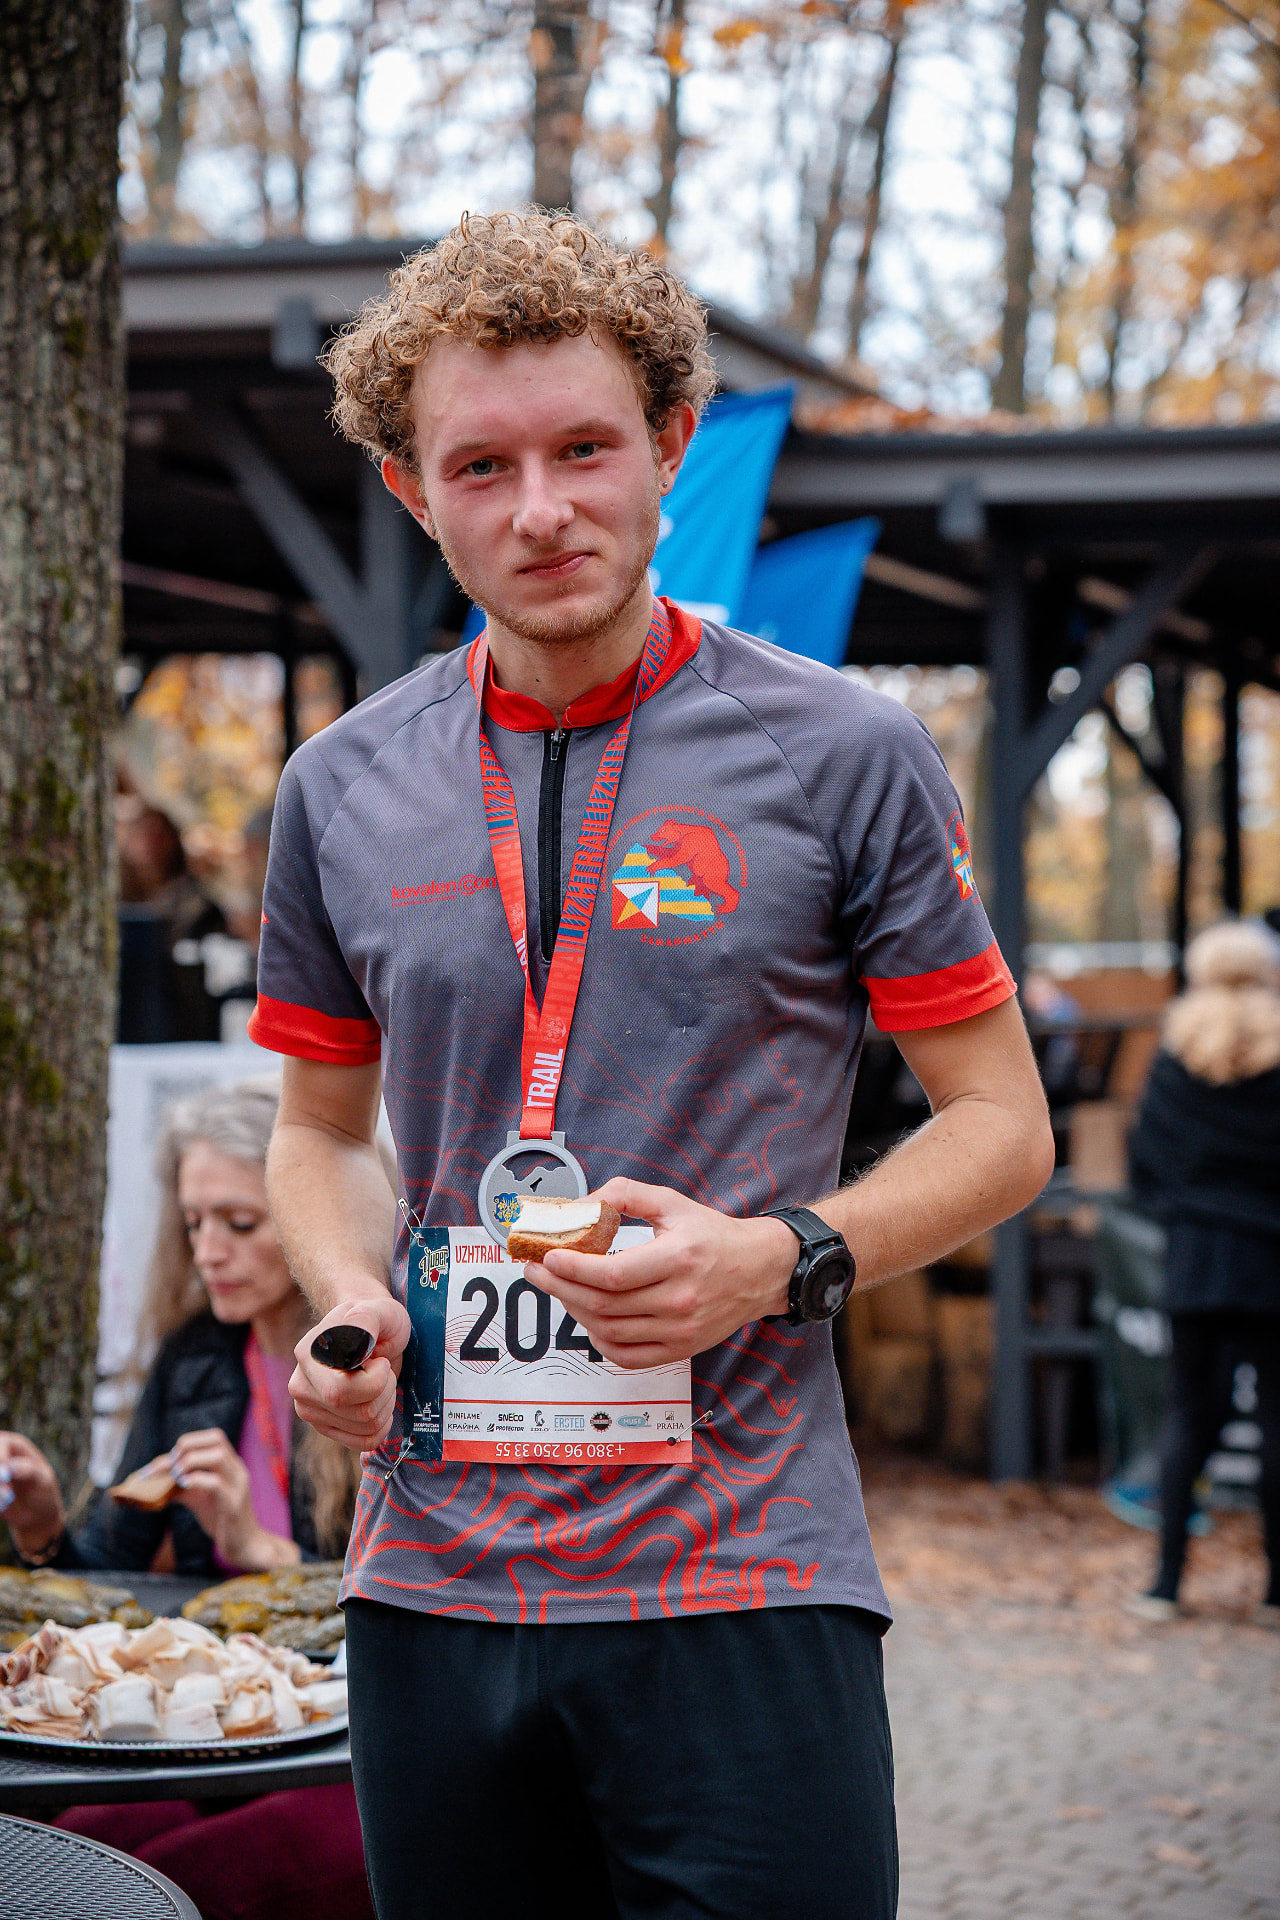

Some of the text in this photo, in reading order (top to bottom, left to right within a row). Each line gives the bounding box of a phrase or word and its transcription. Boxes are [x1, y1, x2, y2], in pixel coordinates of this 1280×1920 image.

[455, 1245, 504, 1263] UZHTRAIL
[656, 1422, 685, 1430] PRAHA
[495, 1442, 626, 1458] +380 96 250 33 55
